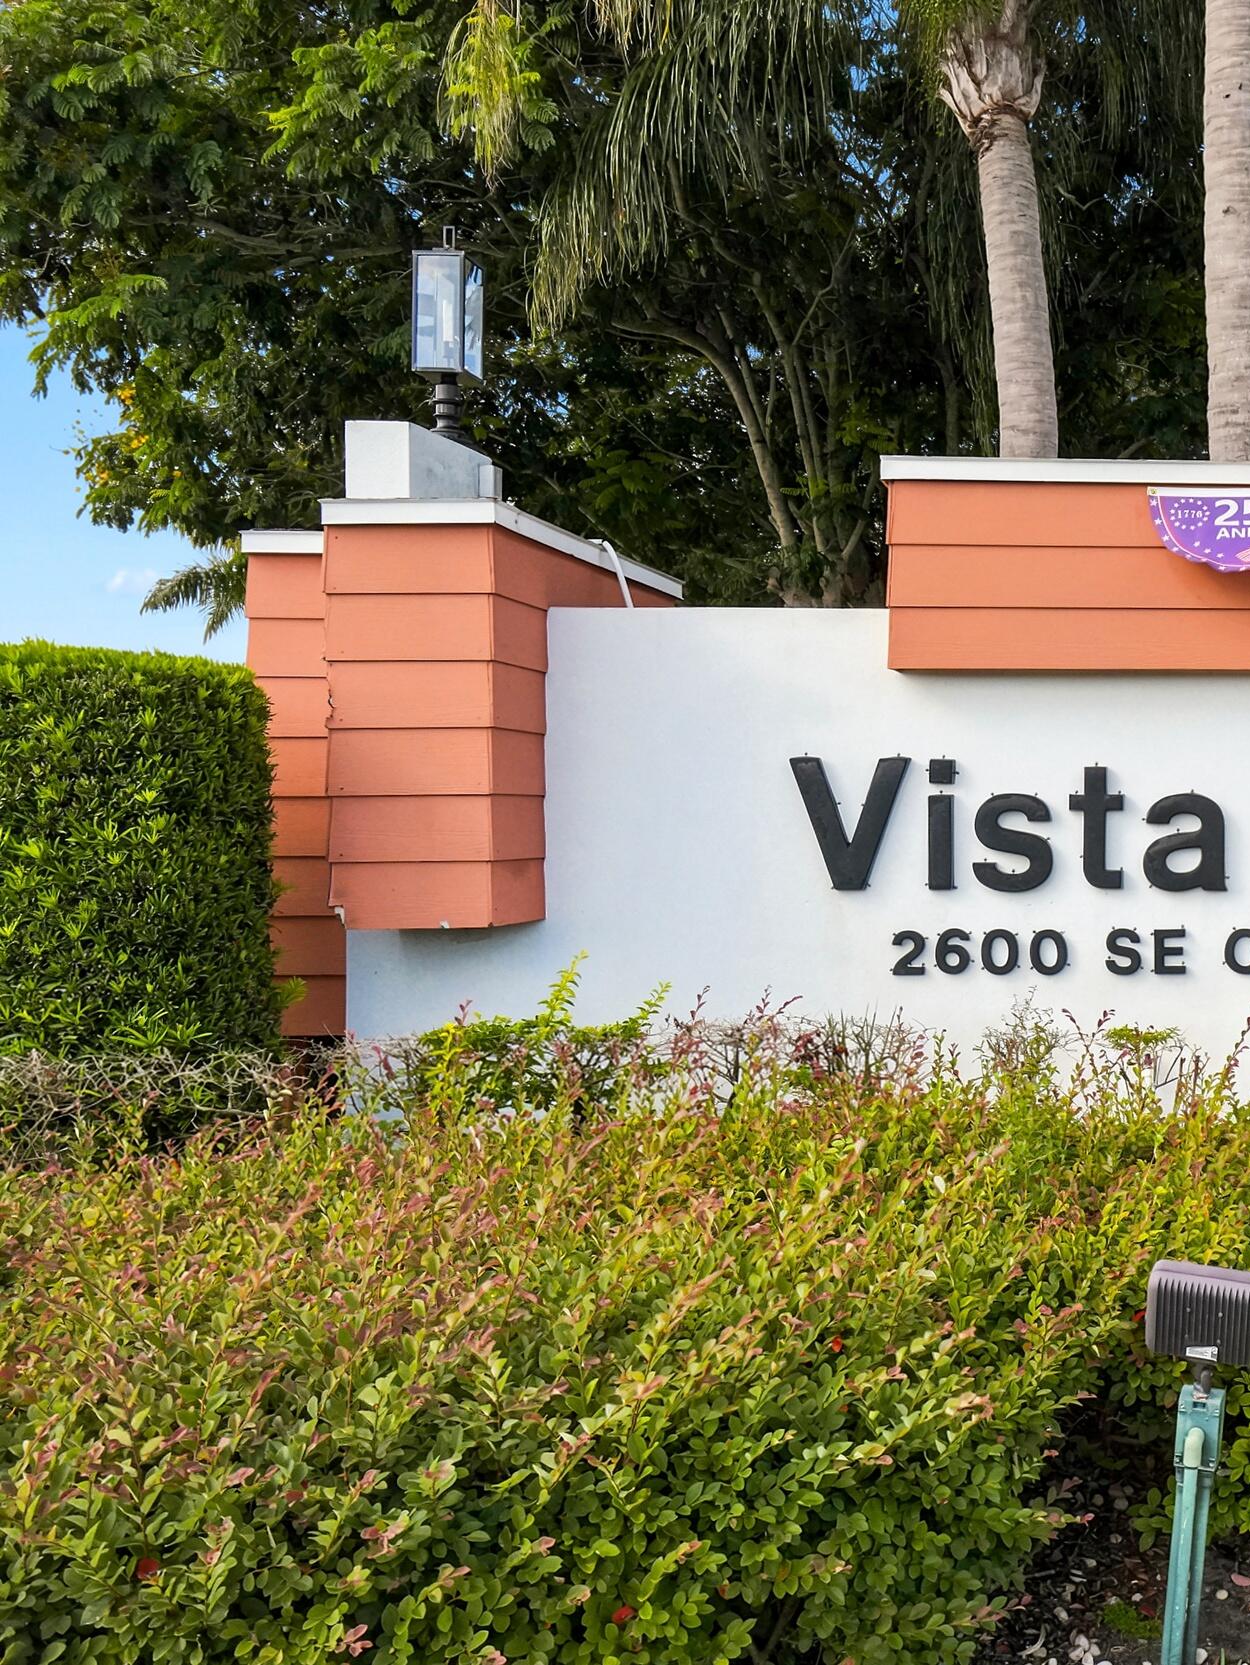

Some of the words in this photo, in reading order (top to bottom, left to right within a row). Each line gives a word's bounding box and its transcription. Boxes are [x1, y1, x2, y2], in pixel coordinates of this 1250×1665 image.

[1177, 509, 1203, 519] 1776
[790, 756, 1229, 893] Vista
[892, 928, 1069, 976] 2600
[1105, 928, 1187, 976] SE
